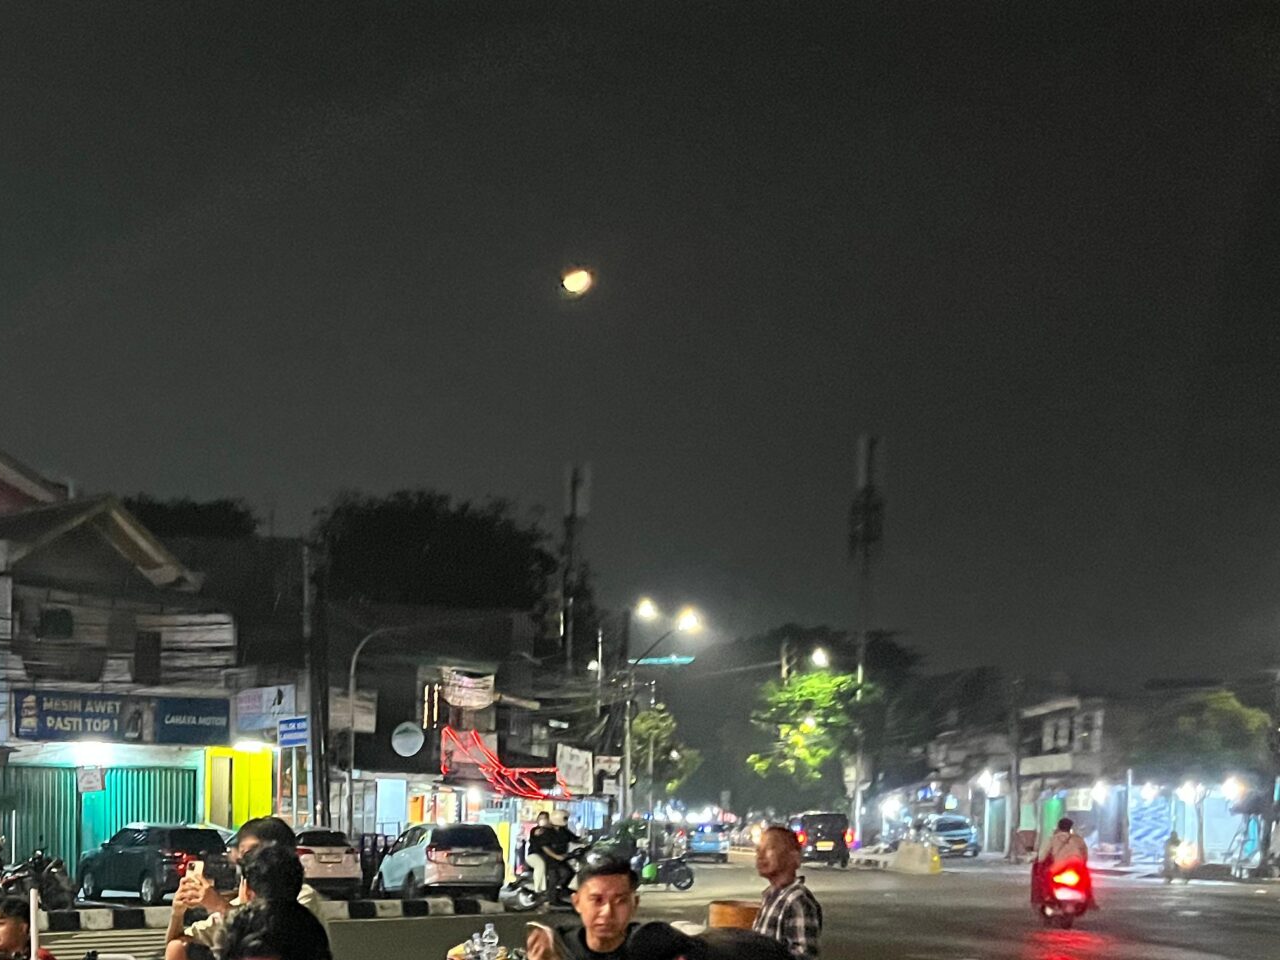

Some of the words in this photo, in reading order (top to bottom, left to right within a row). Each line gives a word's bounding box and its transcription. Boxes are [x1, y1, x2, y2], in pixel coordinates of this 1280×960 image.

[43, 698, 81, 712] MESIN
[84, 701, 121, 713] AWET
[47, 716, 83, 731] PASTI
[85, 719, 110, 732] TOP
